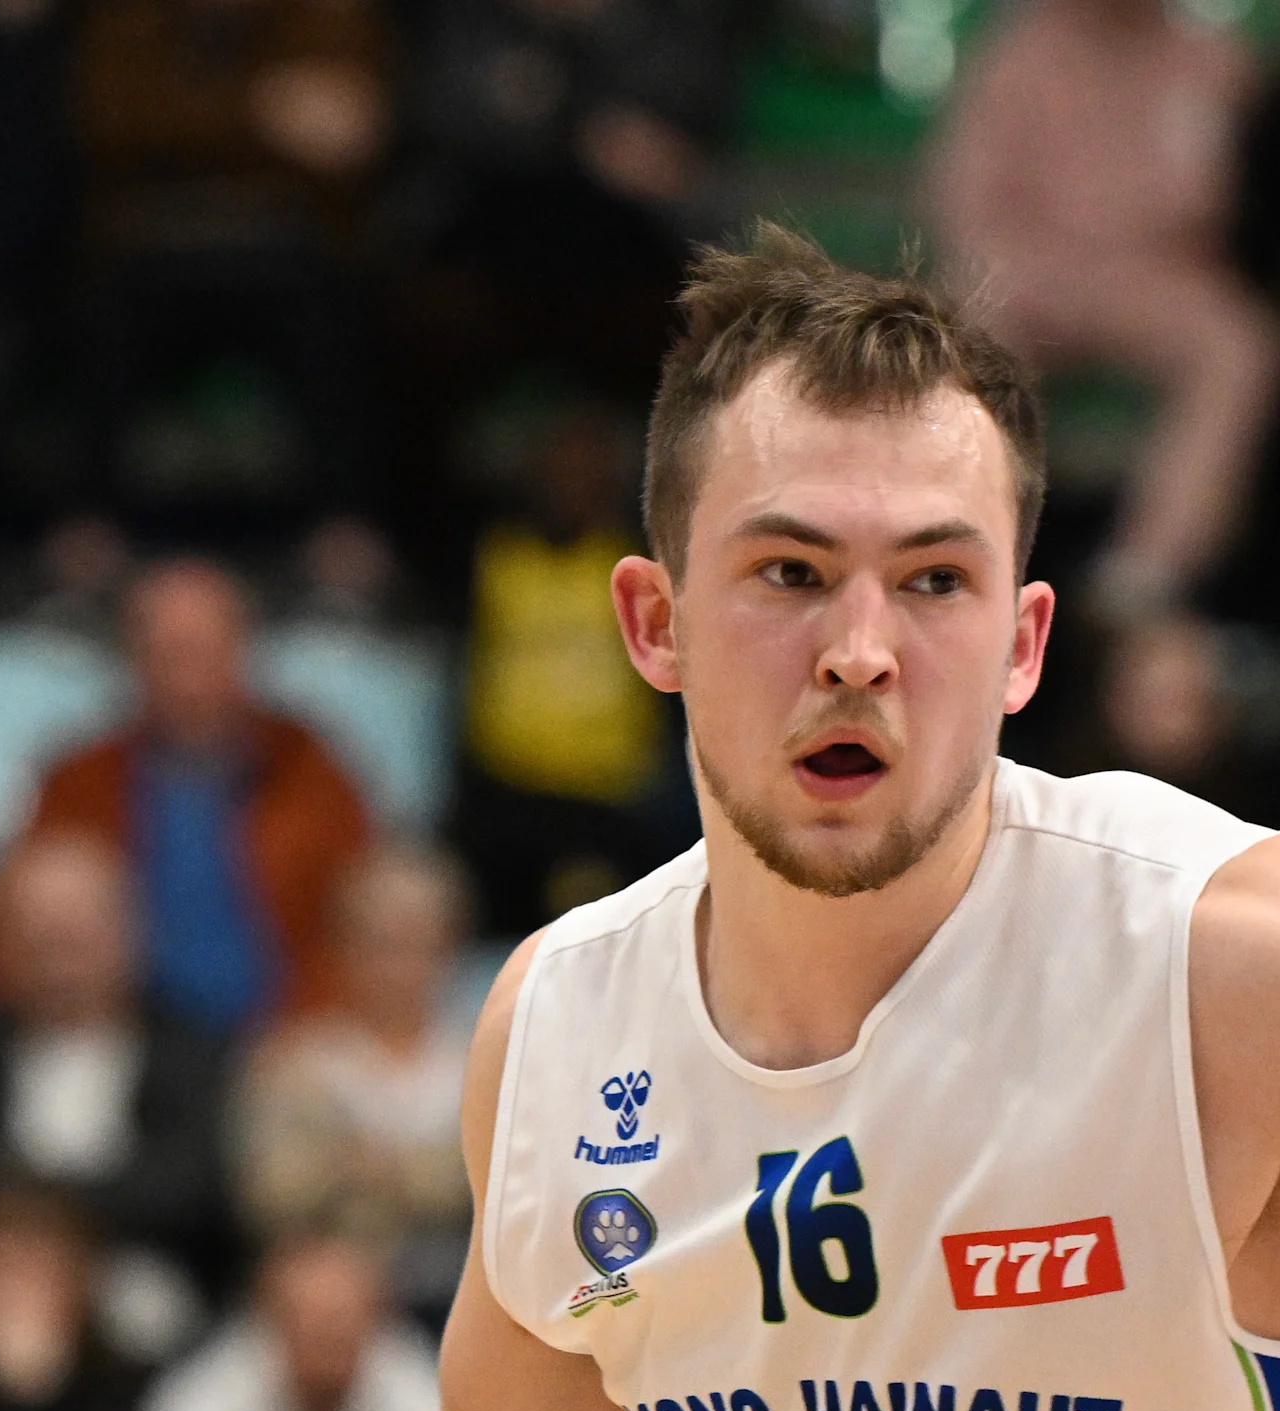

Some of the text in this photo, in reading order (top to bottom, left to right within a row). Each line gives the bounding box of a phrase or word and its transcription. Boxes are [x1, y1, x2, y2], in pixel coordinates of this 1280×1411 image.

[574, 1134, 660, 1165] hummel
[744, 1133, 880, 1325] 16
[965, 1232, 1099, 1298] 777
